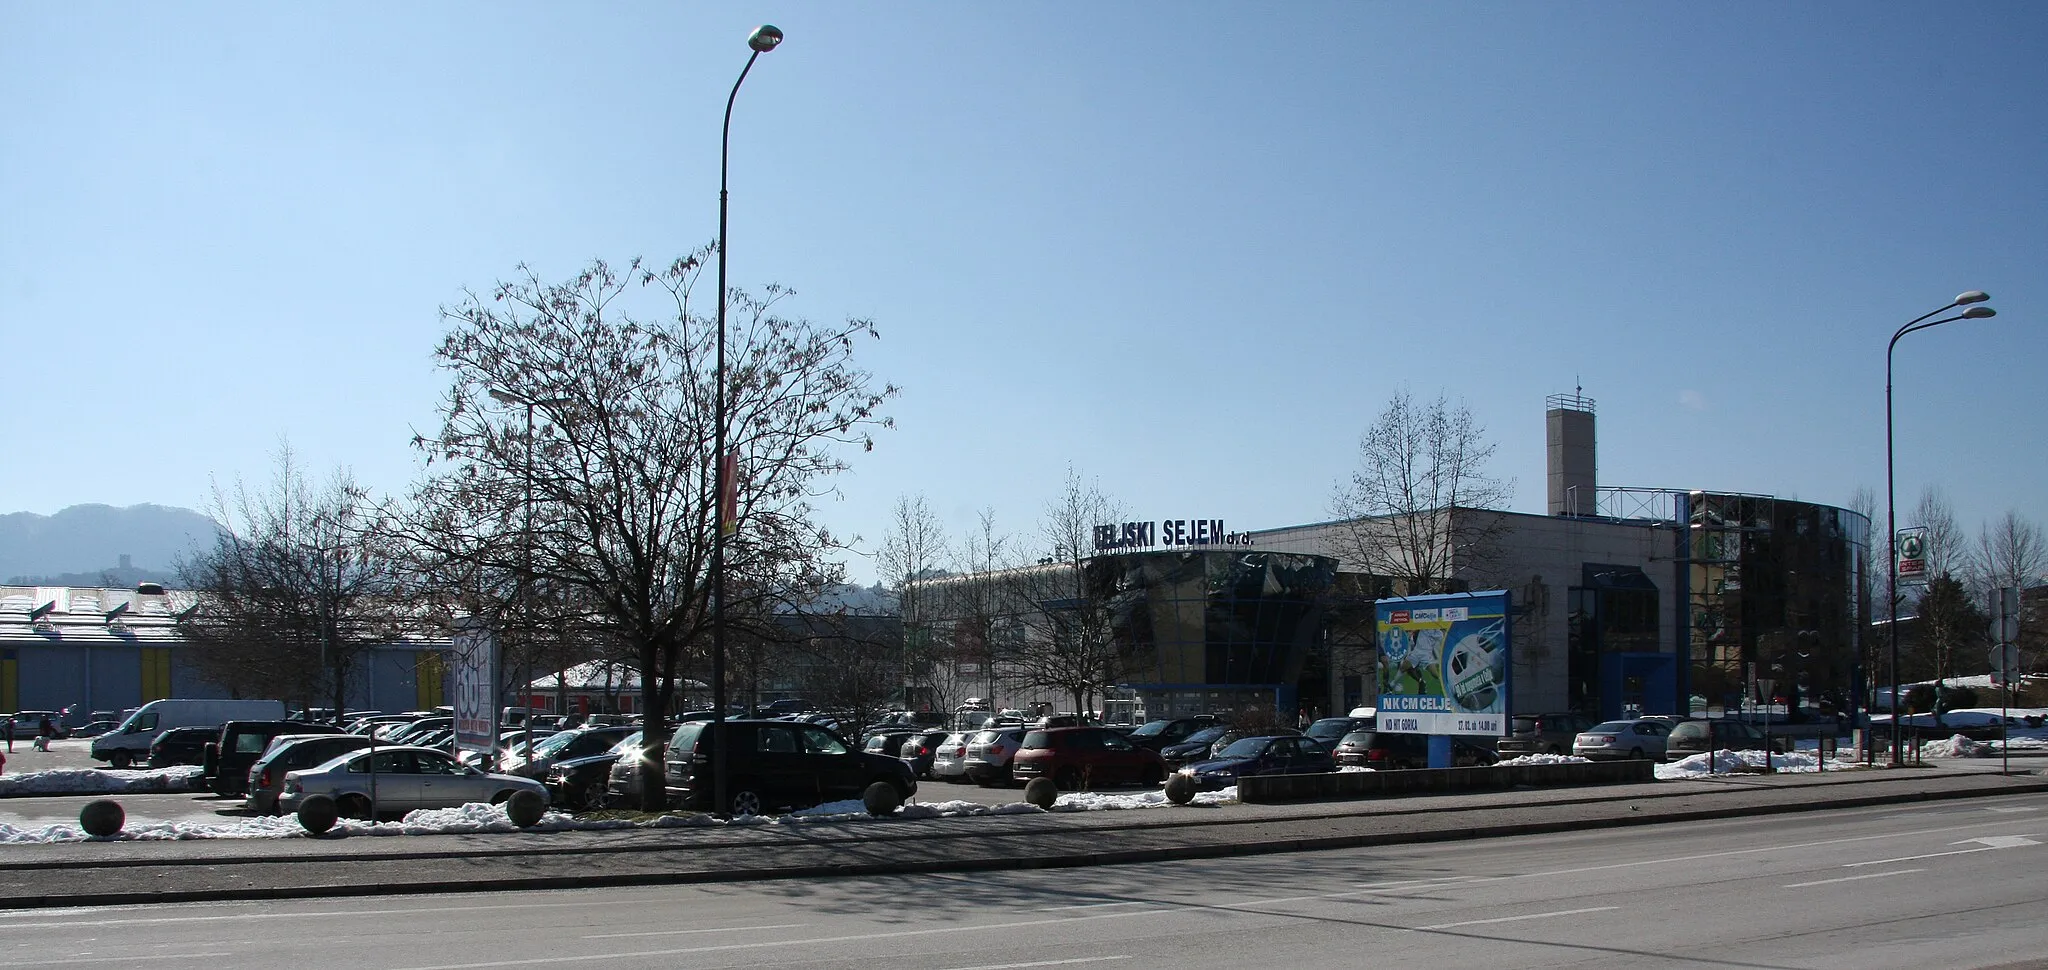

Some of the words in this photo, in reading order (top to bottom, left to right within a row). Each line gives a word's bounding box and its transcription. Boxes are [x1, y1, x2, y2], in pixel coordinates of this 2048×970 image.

[1162, 519, 1224, 546] SEJEM
[1383, 698, 1400, 710] NK
[1401, 698, 1418, 710] CM
[1419, 698, 1451, 711] CELJE
